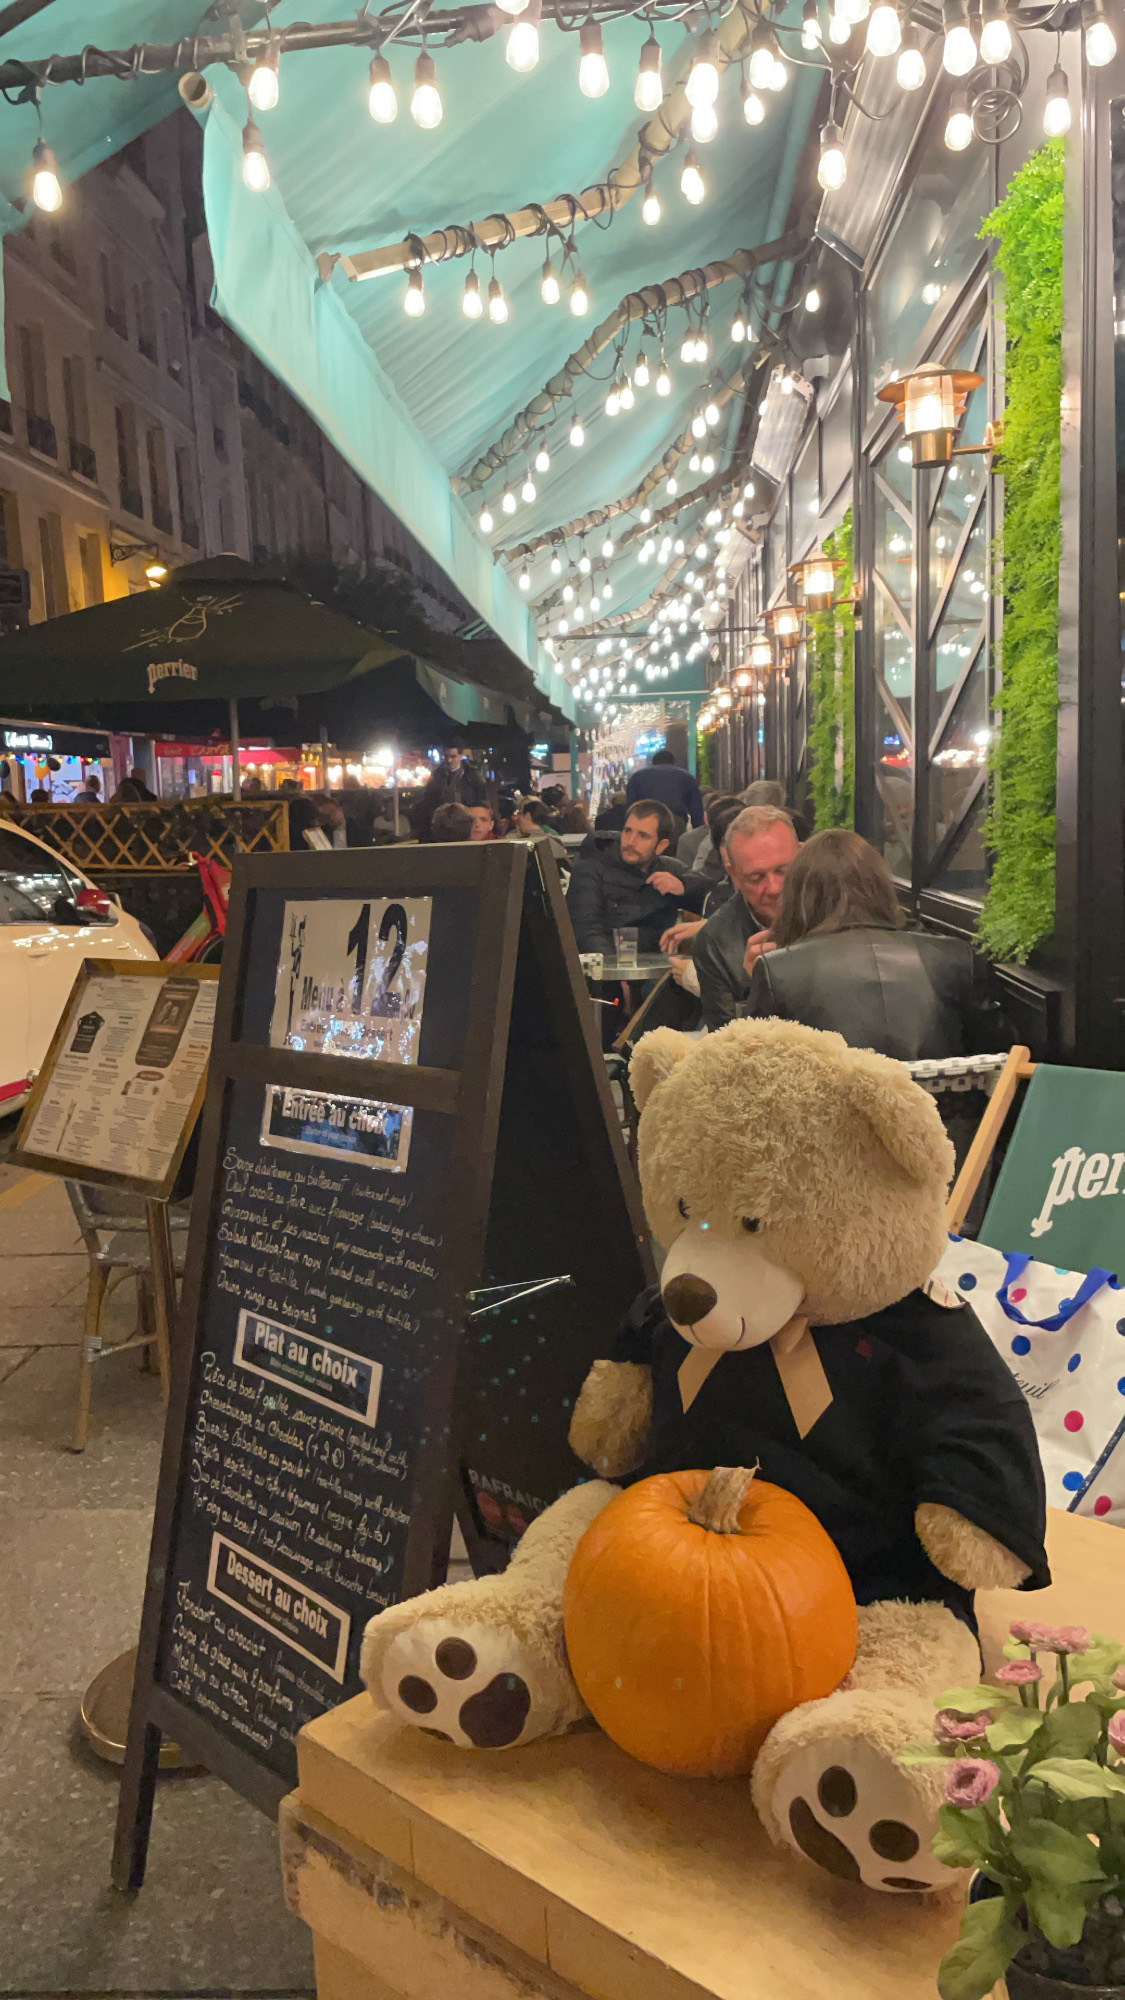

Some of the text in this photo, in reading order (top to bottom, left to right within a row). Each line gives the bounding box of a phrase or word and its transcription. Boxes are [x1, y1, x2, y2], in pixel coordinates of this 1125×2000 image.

[146, 658, 198, 694] perrier
[281, 1089, 326, 1124] Entrée
[328, 1104, 346, 1128] au
[223, 1147, 254, 1172] Soupe
[294, 1172, 306, 1183] au
[1029, 1146, 1125, 1238] per
[221, 1198, 270, 1226] Guacamole
[271, 1214, 284, 1230] et
[297, 1224, 330, 1244] nachos
[385, 1249, 406, 1266] with
[326, 1196, 365, 1230] fromage
[217, 1222, 249, 1245] Salade
[282, 1249, 300, 1263] aux
[256, 1261, 268, 1277] et
[242, 1286, 265, 1312] rings
[254, 1320, 360, 1389] Plat au choix
[200, 1351, 226, 1387] Pièce
[226, 1372, 239, 1391] de
[291, 1409, 318, 1430] sauce
[195, 1410, 230, 1442] Burrito
[279, 1455, 311, 1479] poulet
[254, 1418, 267, 1433] au
[267, 1420, 305, 1451] Cheddar
[190, 1458, 210, 1483] Duo
[209, 1471, 221, 1490] de
[256, 1503, 269, 1517] au
[267, 1509, 301, 1538] saumon
[205, 1495, 222, 1526] dog
[221, 1510, 233, 1524] au
[227, 1550, 330, 1640] Dessert au choix
[177, 1580, 267, 1658] Fondant au chocolat
[172, 1612, 198, 1646] Coupe
[199, 1632, 210, 1655] de
[208, 1644, 232, 1670] glace
[231, 1662, 249, 1684] aux
[169, 1670, 194, 1695] Café
